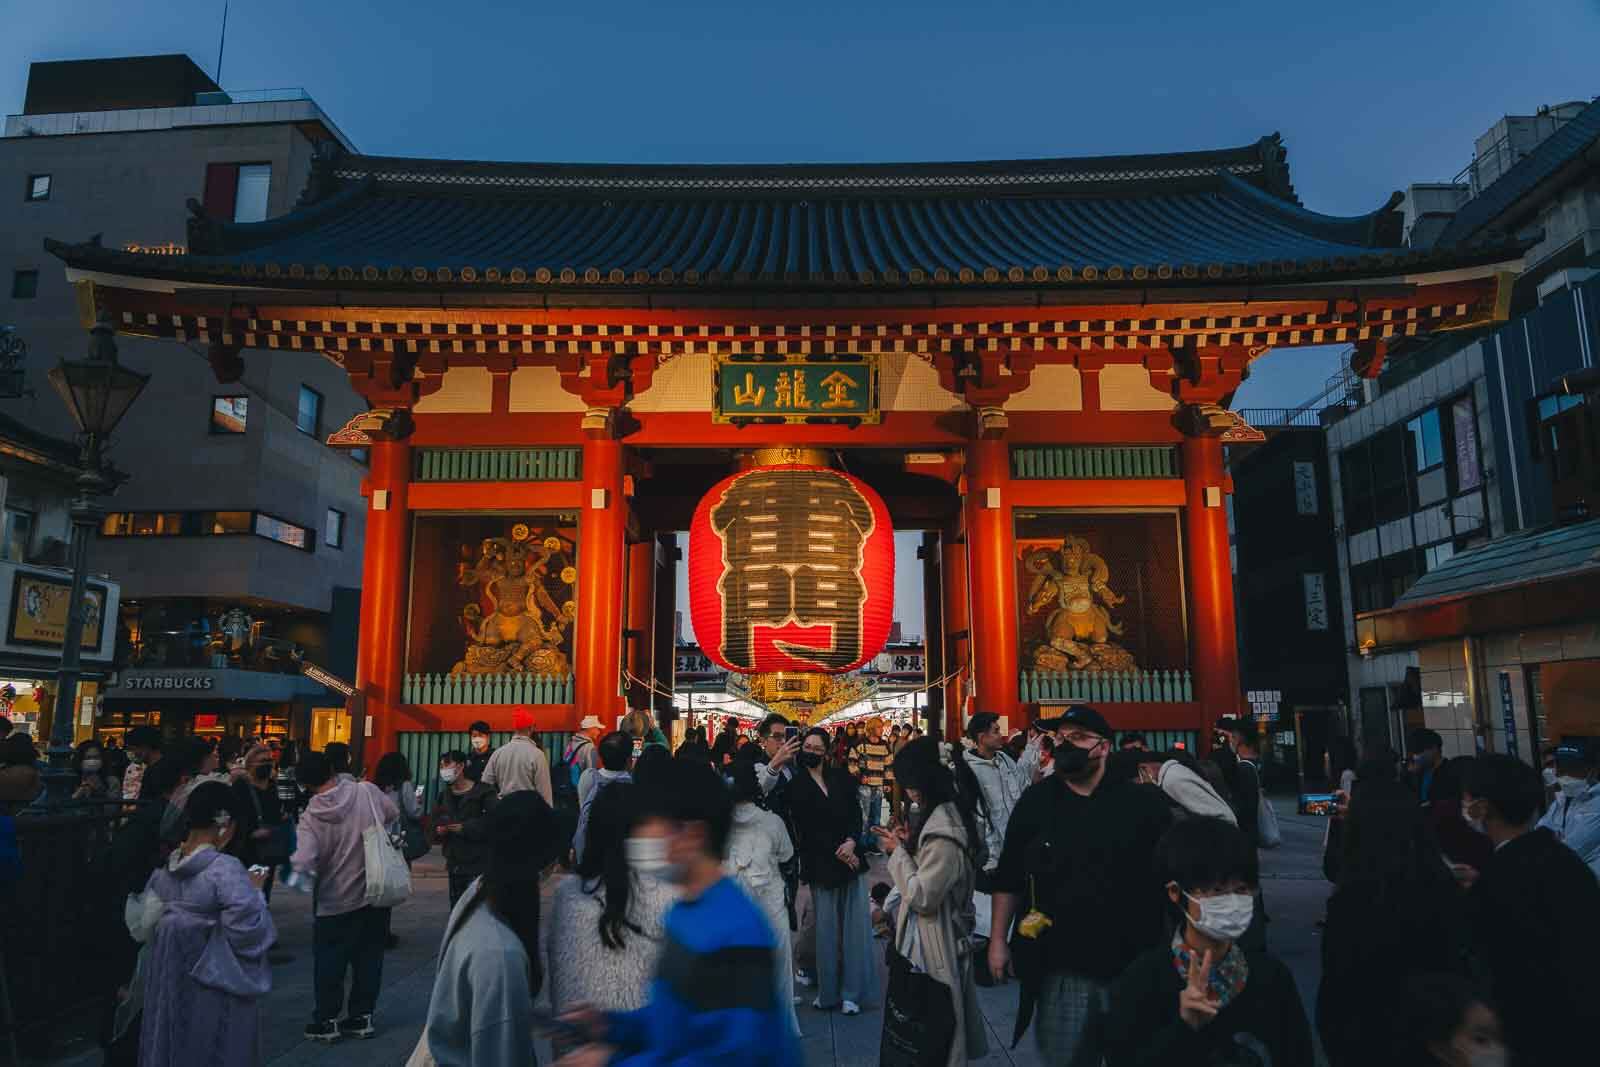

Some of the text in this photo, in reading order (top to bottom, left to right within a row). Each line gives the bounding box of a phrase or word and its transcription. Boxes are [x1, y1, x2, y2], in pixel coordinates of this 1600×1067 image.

[709, 469, 876, 669] 雷門
[895, 655, 926, 672] 仲見
[126, 677, 213, 689] STARBUCKS
